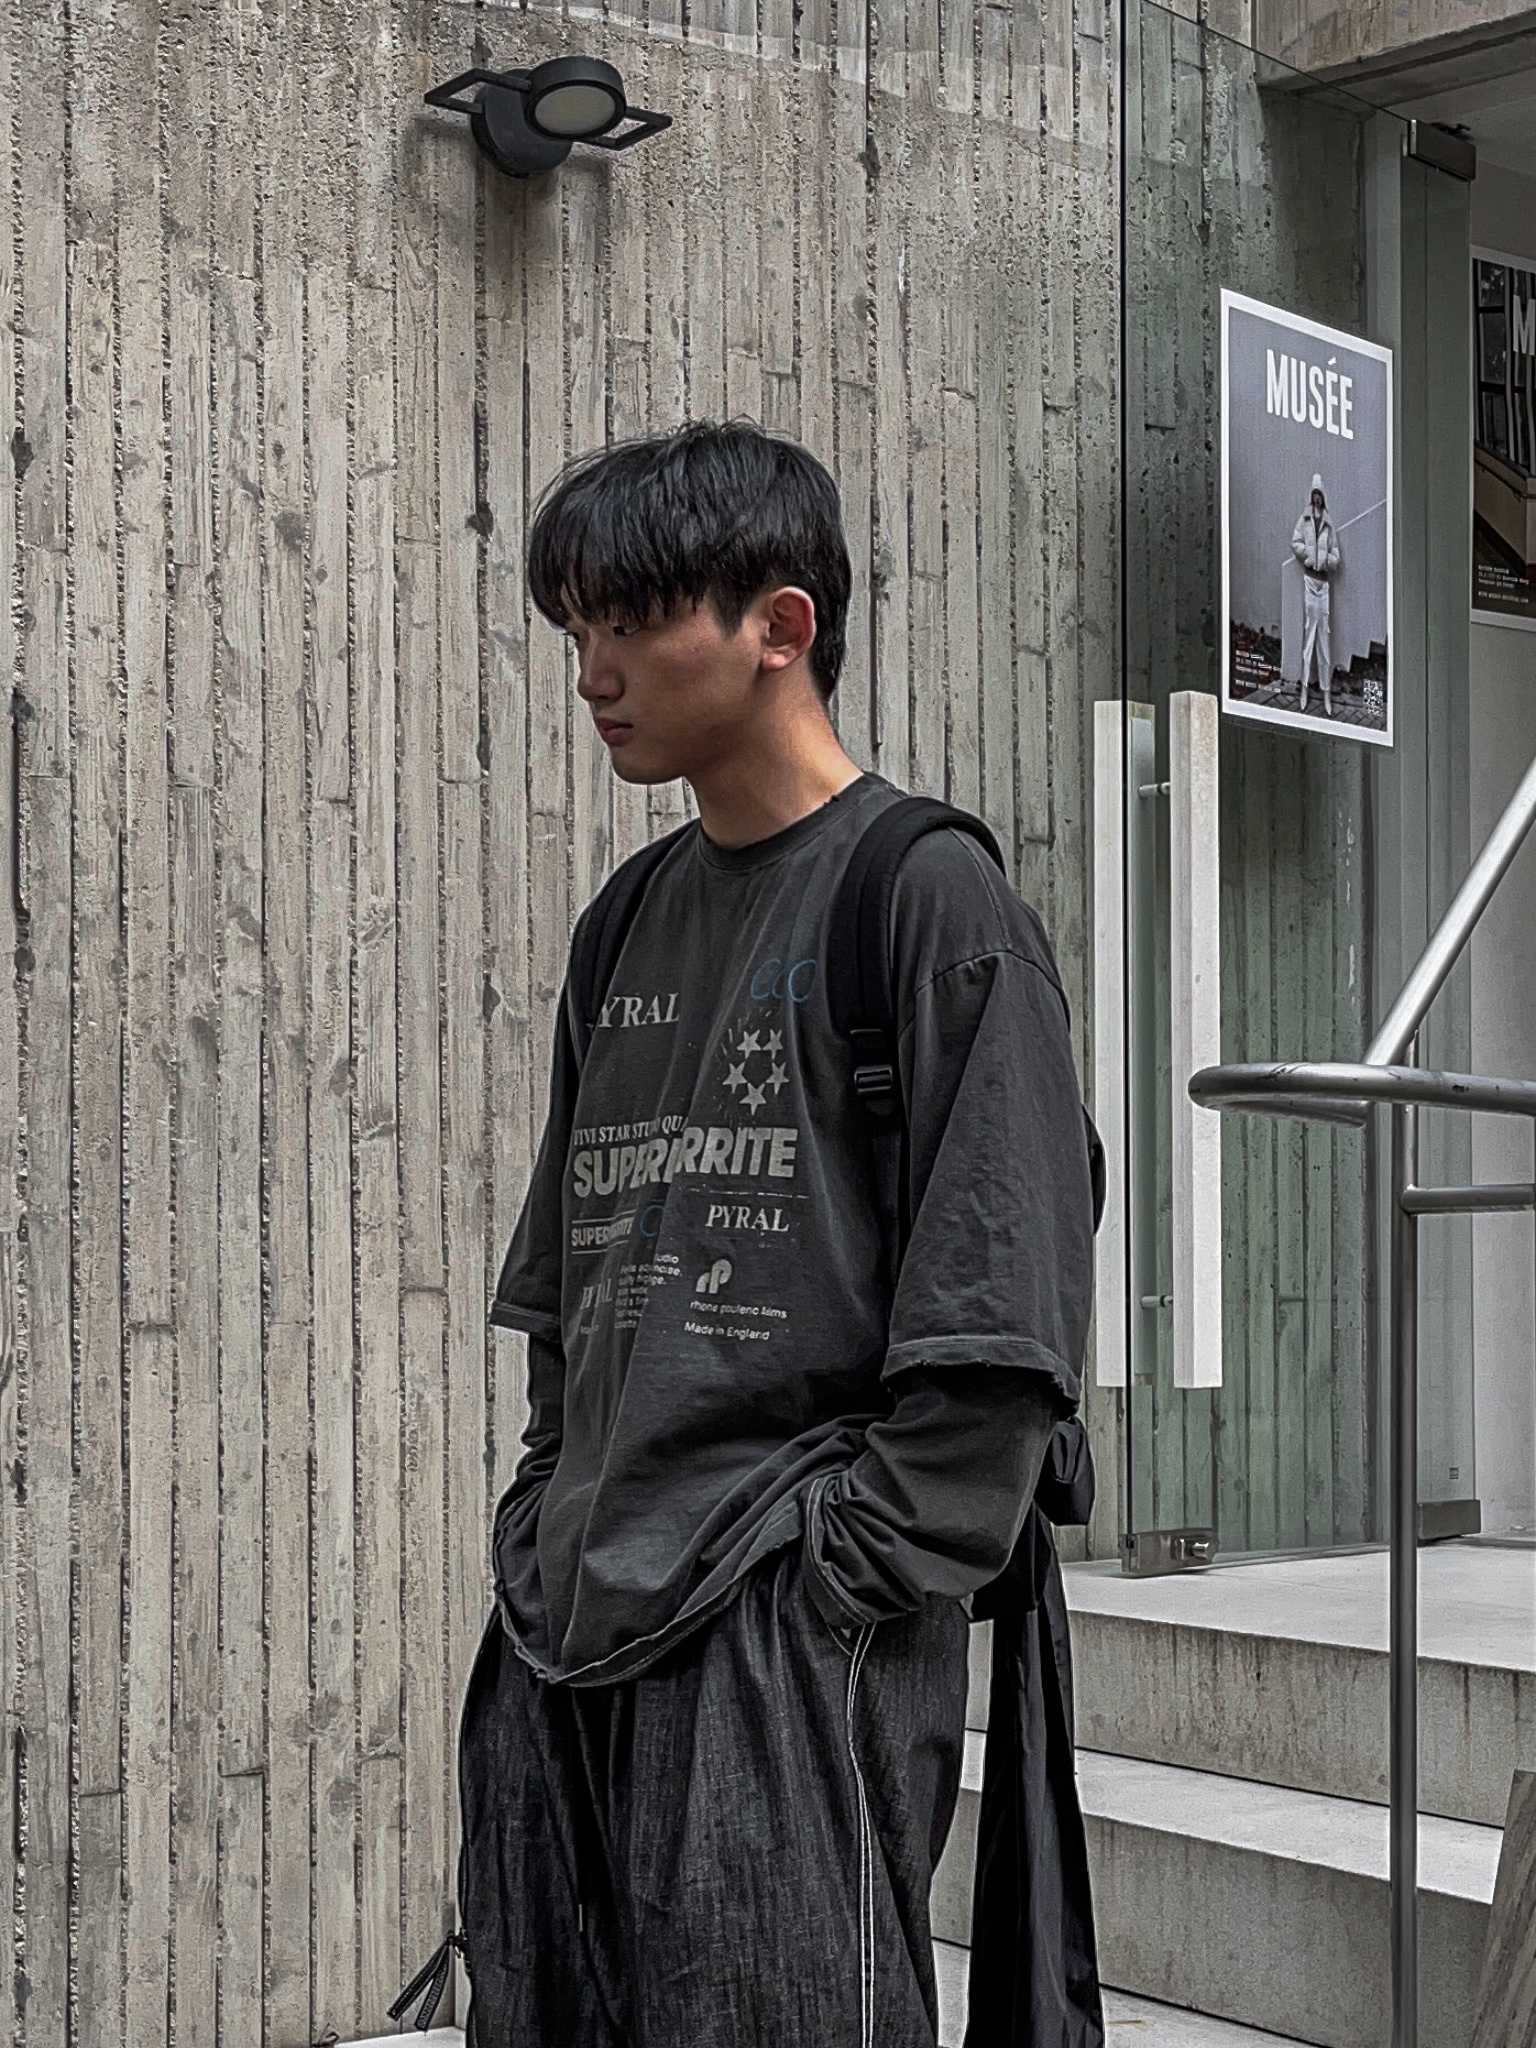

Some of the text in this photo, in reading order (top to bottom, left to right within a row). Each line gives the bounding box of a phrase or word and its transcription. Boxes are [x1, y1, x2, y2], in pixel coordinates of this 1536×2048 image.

[1266, 349, 1354, 440] MUSÉE
[705, 1204, 790, 1233] PYRAL
[683, 1321, 714, 1336] Made
[726, 1326, 770, 1341] England
